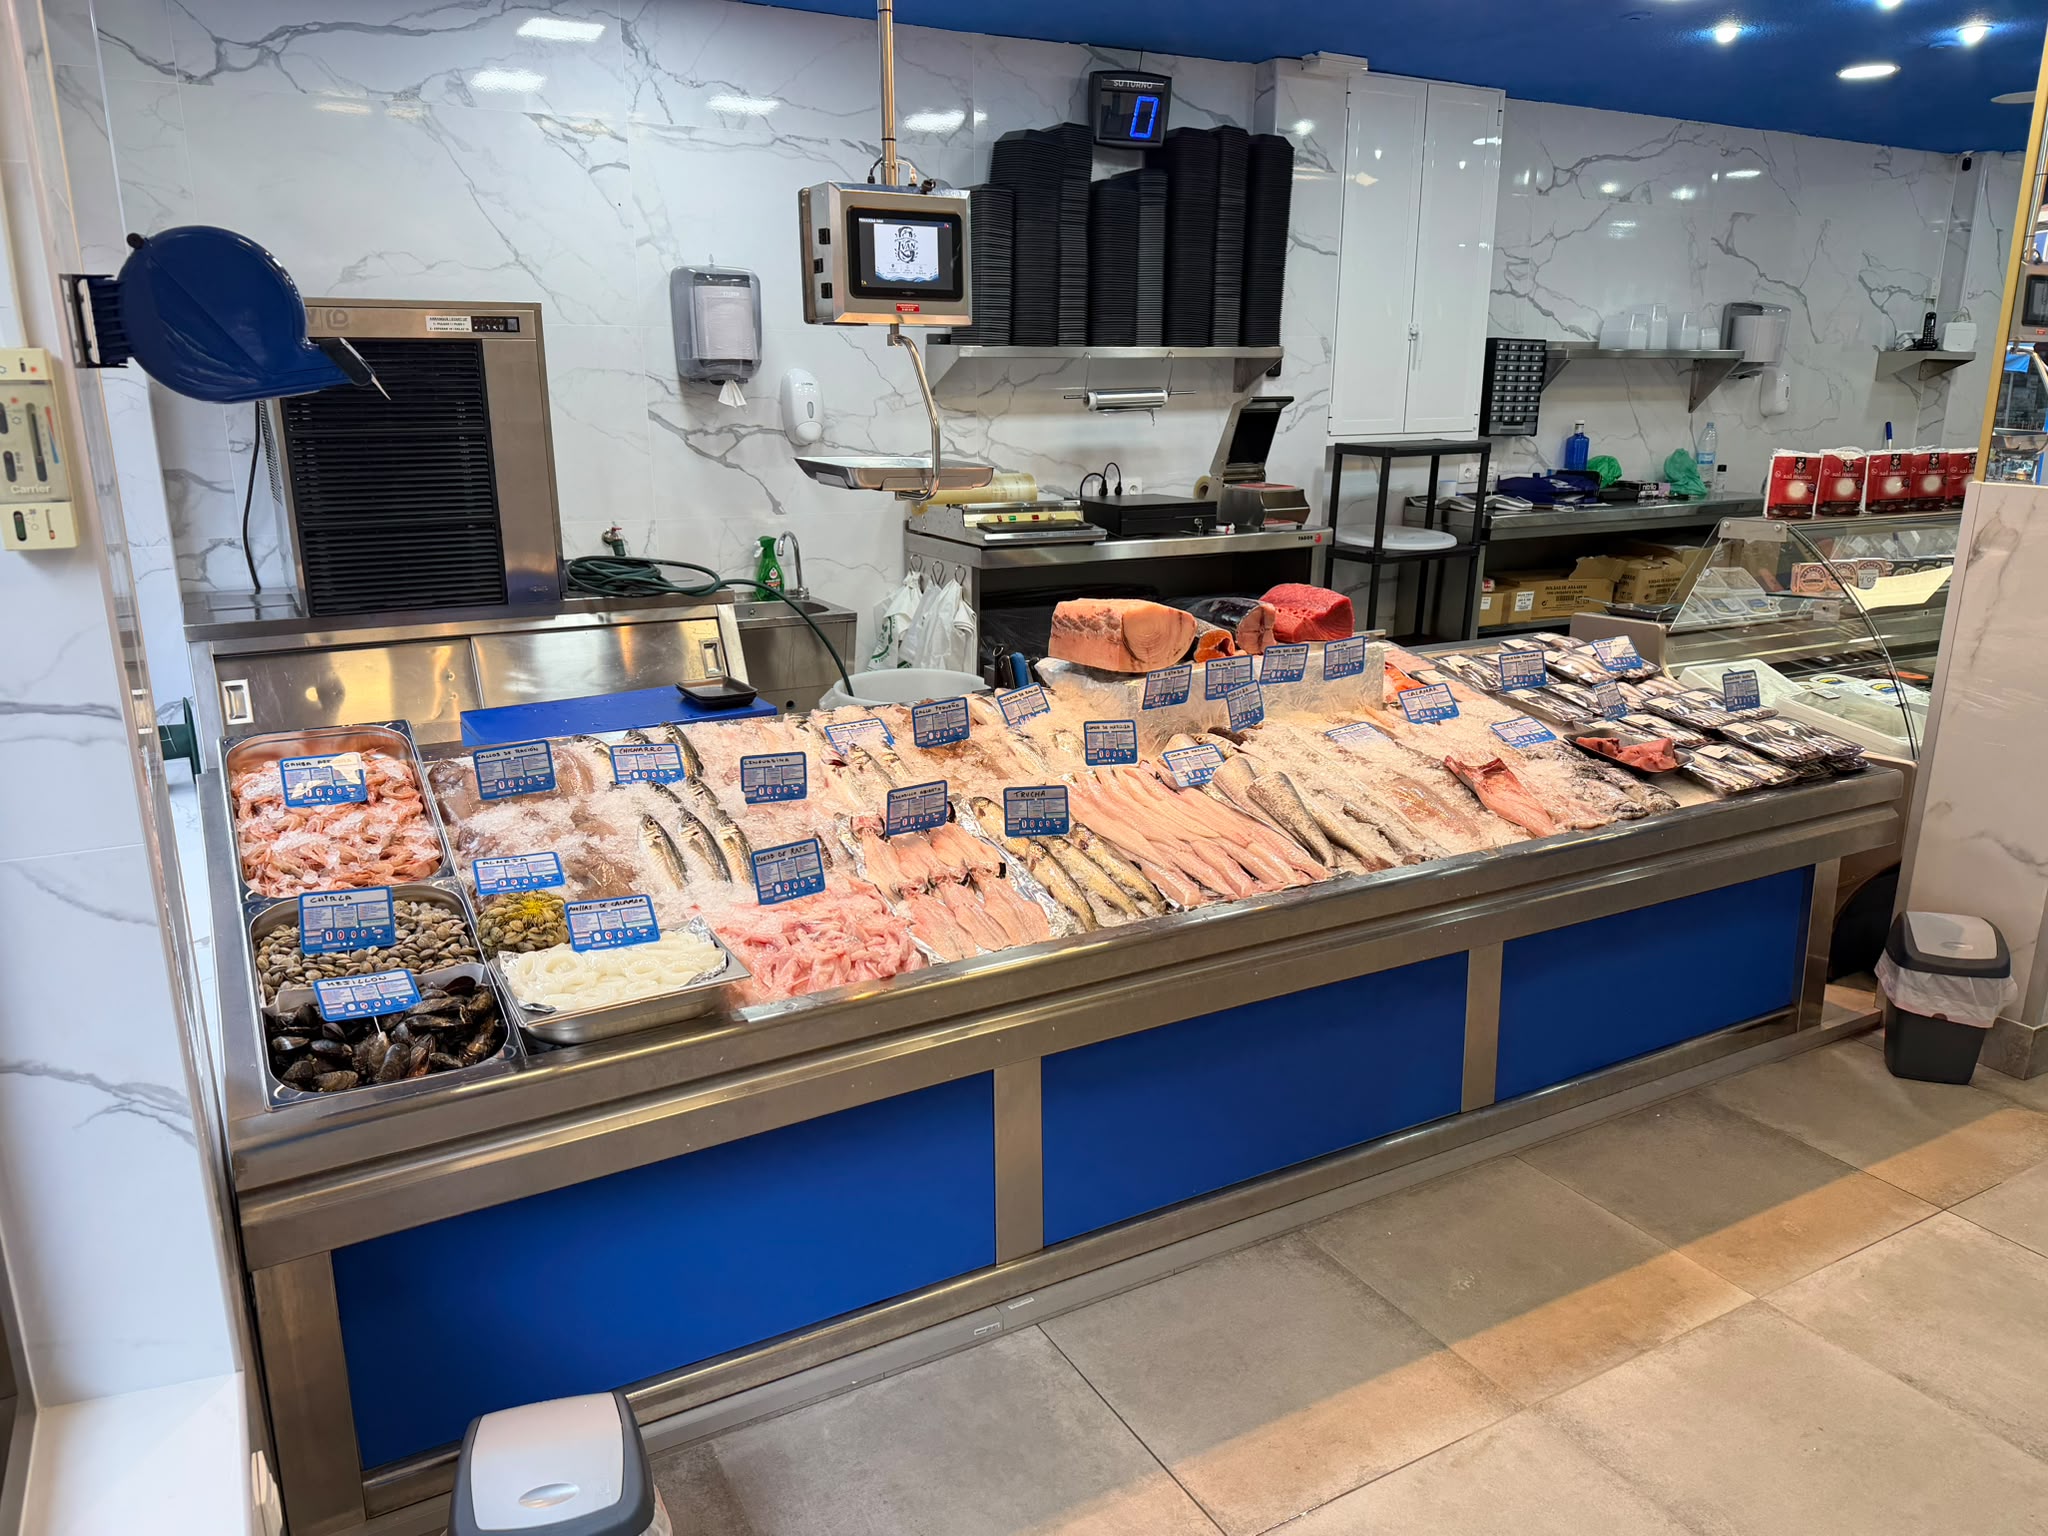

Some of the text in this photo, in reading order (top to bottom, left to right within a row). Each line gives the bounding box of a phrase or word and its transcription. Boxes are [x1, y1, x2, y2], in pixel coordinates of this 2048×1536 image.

[1129, 95, 1160, 139] 0
[10, 484, 51, 494] Carrier
[1013, 790, 1046, 798] TRUCHA
[790, 844, 809, 855] RAPE
